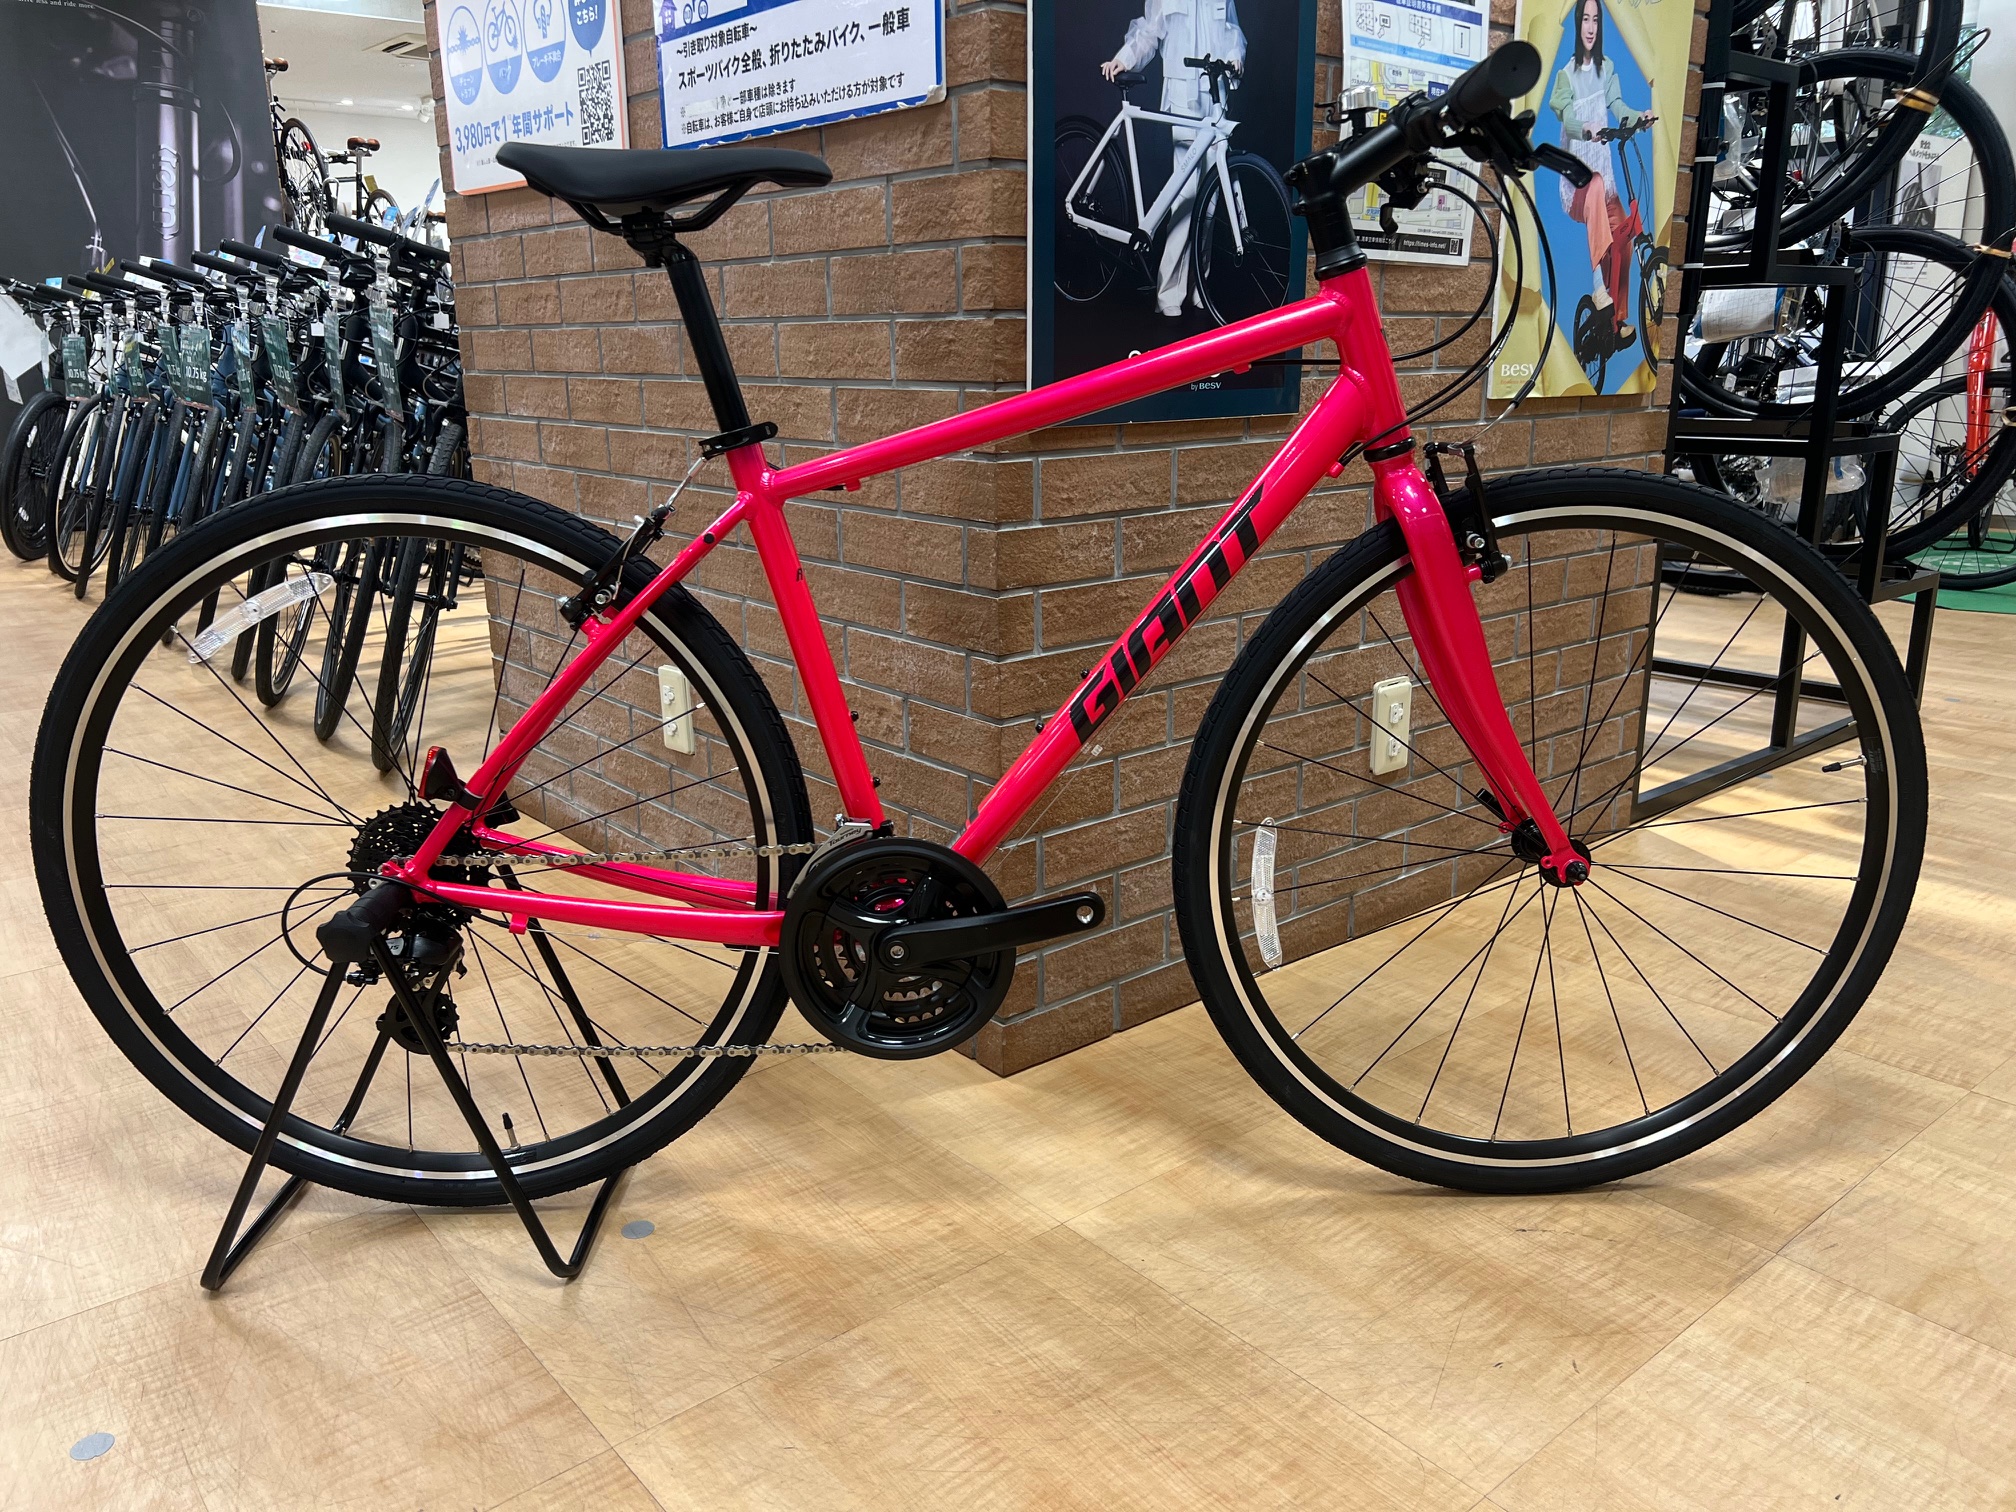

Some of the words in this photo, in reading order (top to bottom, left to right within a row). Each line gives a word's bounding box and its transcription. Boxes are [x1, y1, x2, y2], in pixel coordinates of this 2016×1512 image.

[678, 6, 911, 91] スポーツバイク全般、折りたたみバイク、一般車
[1190, 383, 1199, 392] by
[1069, 481, 1266, 746] GIANT
